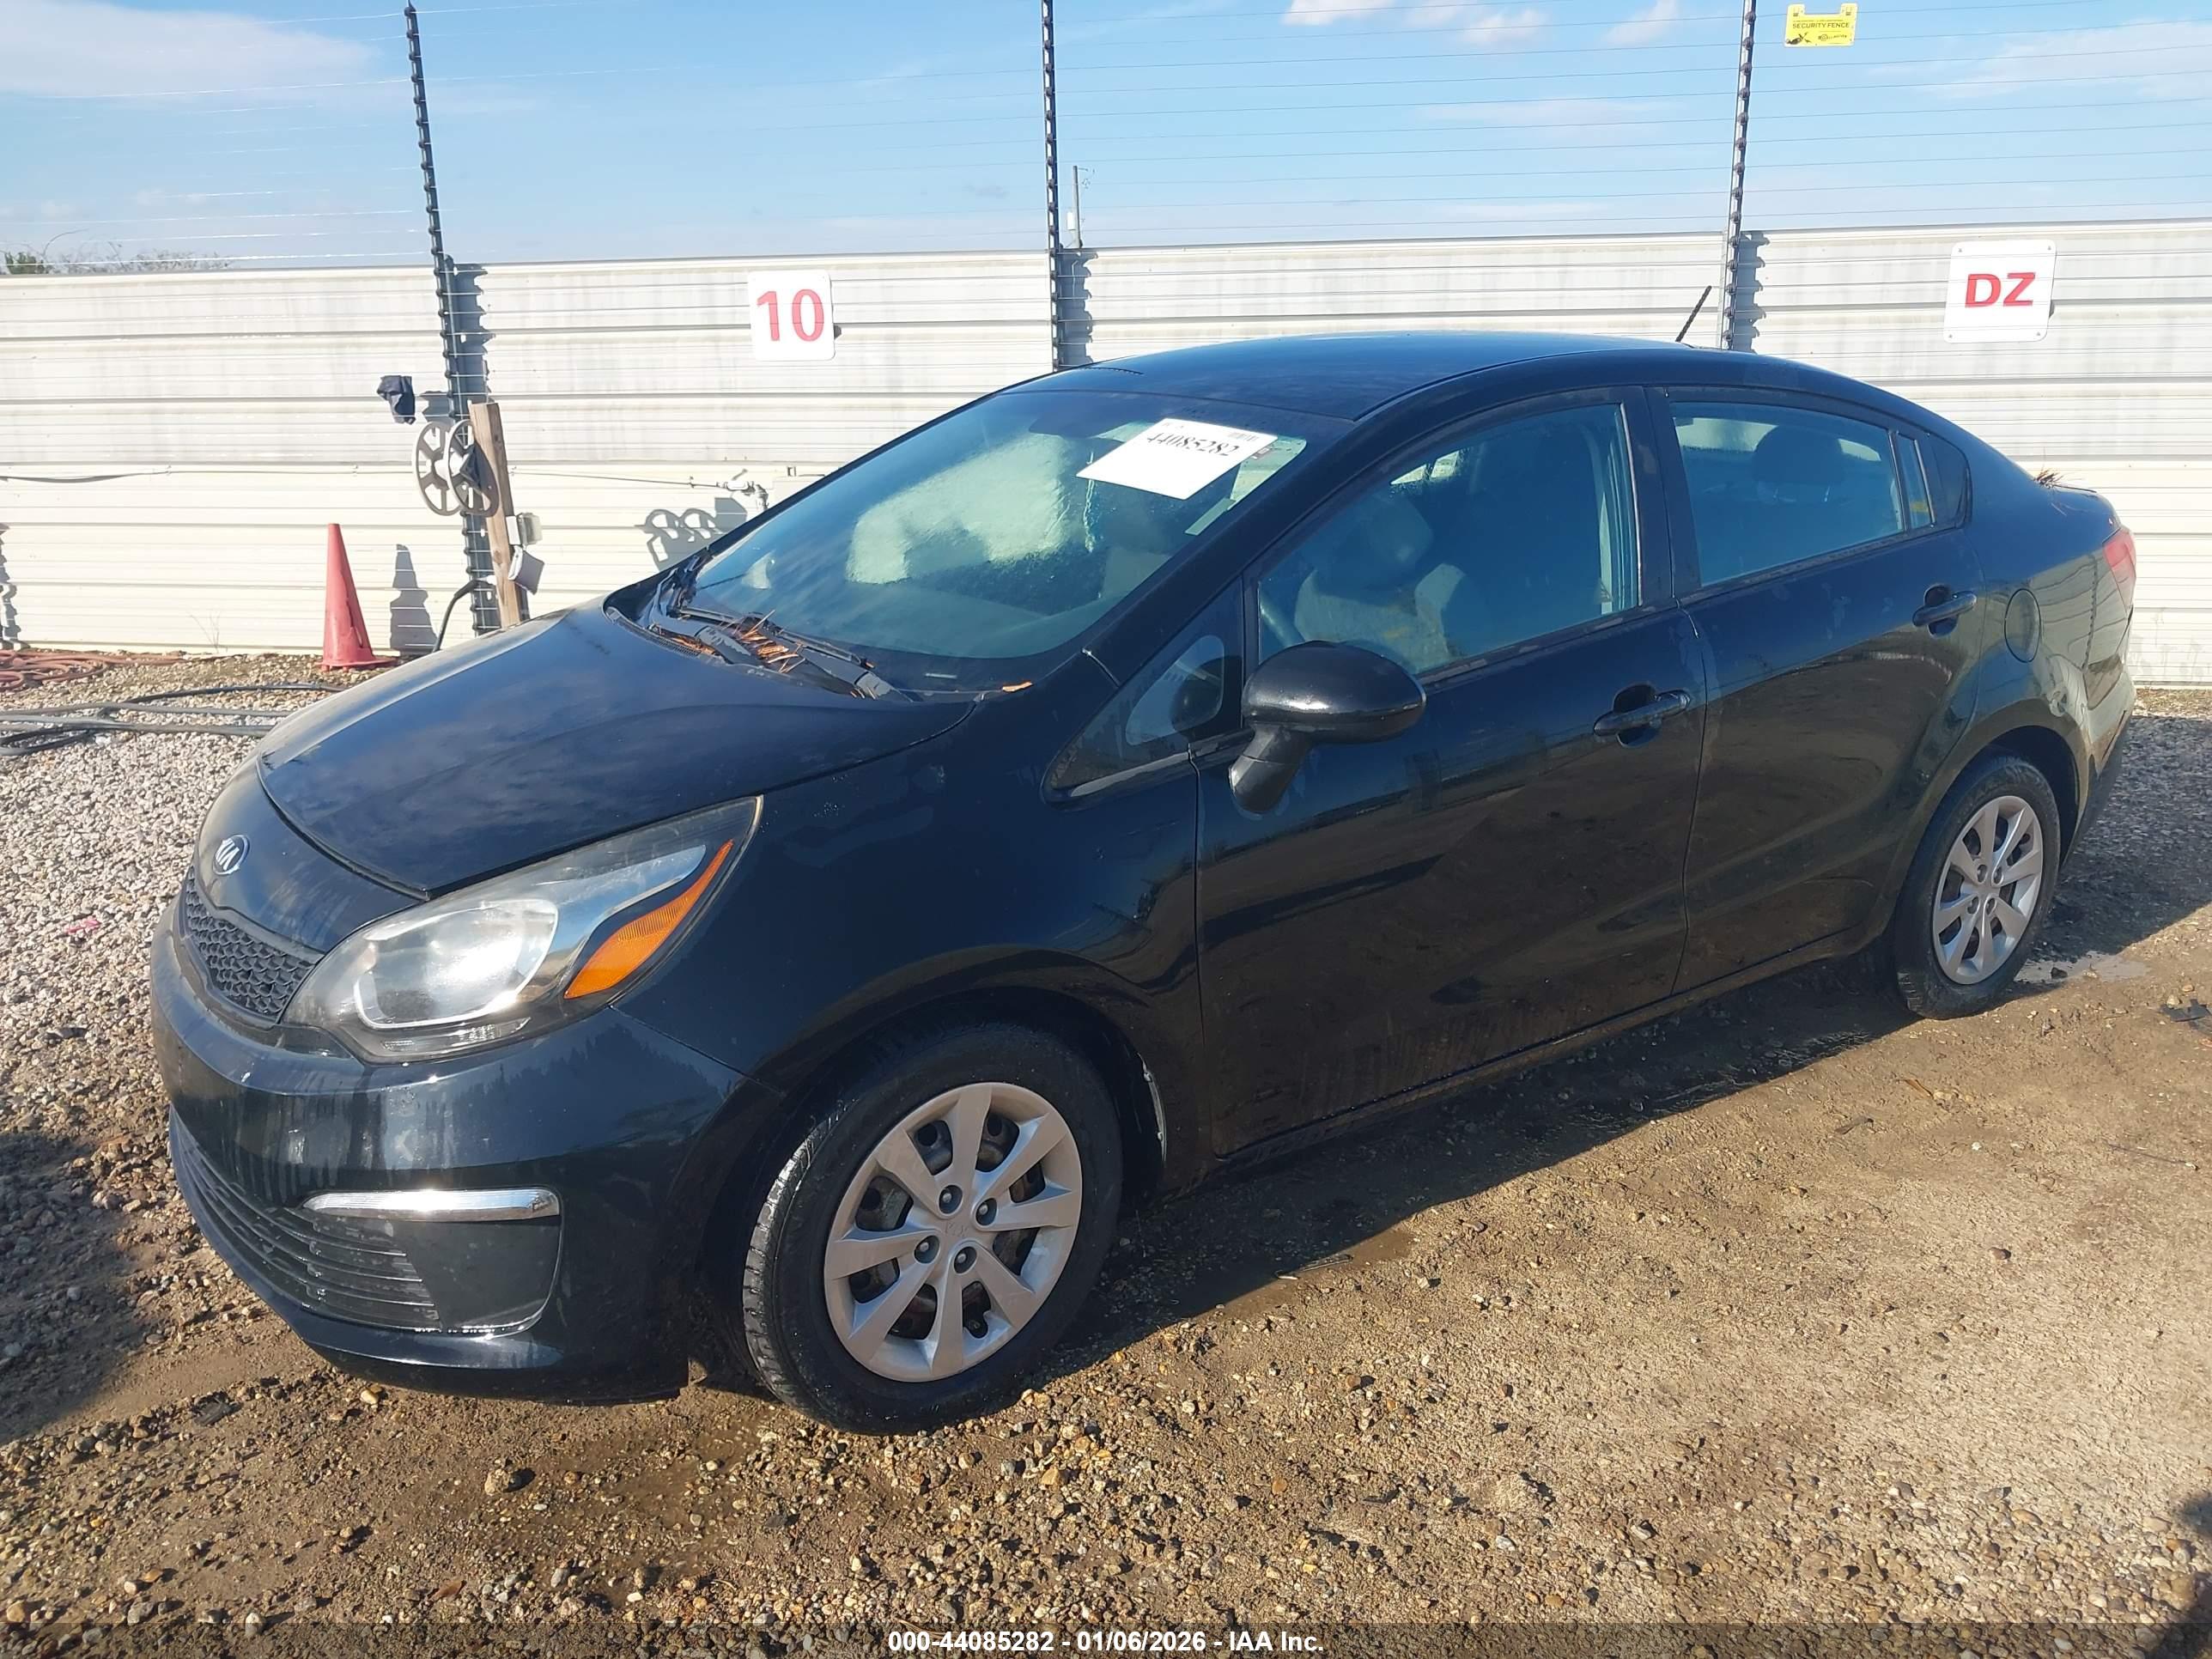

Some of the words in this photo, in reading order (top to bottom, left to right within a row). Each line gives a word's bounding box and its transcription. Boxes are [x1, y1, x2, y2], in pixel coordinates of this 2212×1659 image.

[1965, 271, 2036, 308] DZ
[757, 289, 824, 342] 10
[1146, 432, 1240, 456] 44085282
